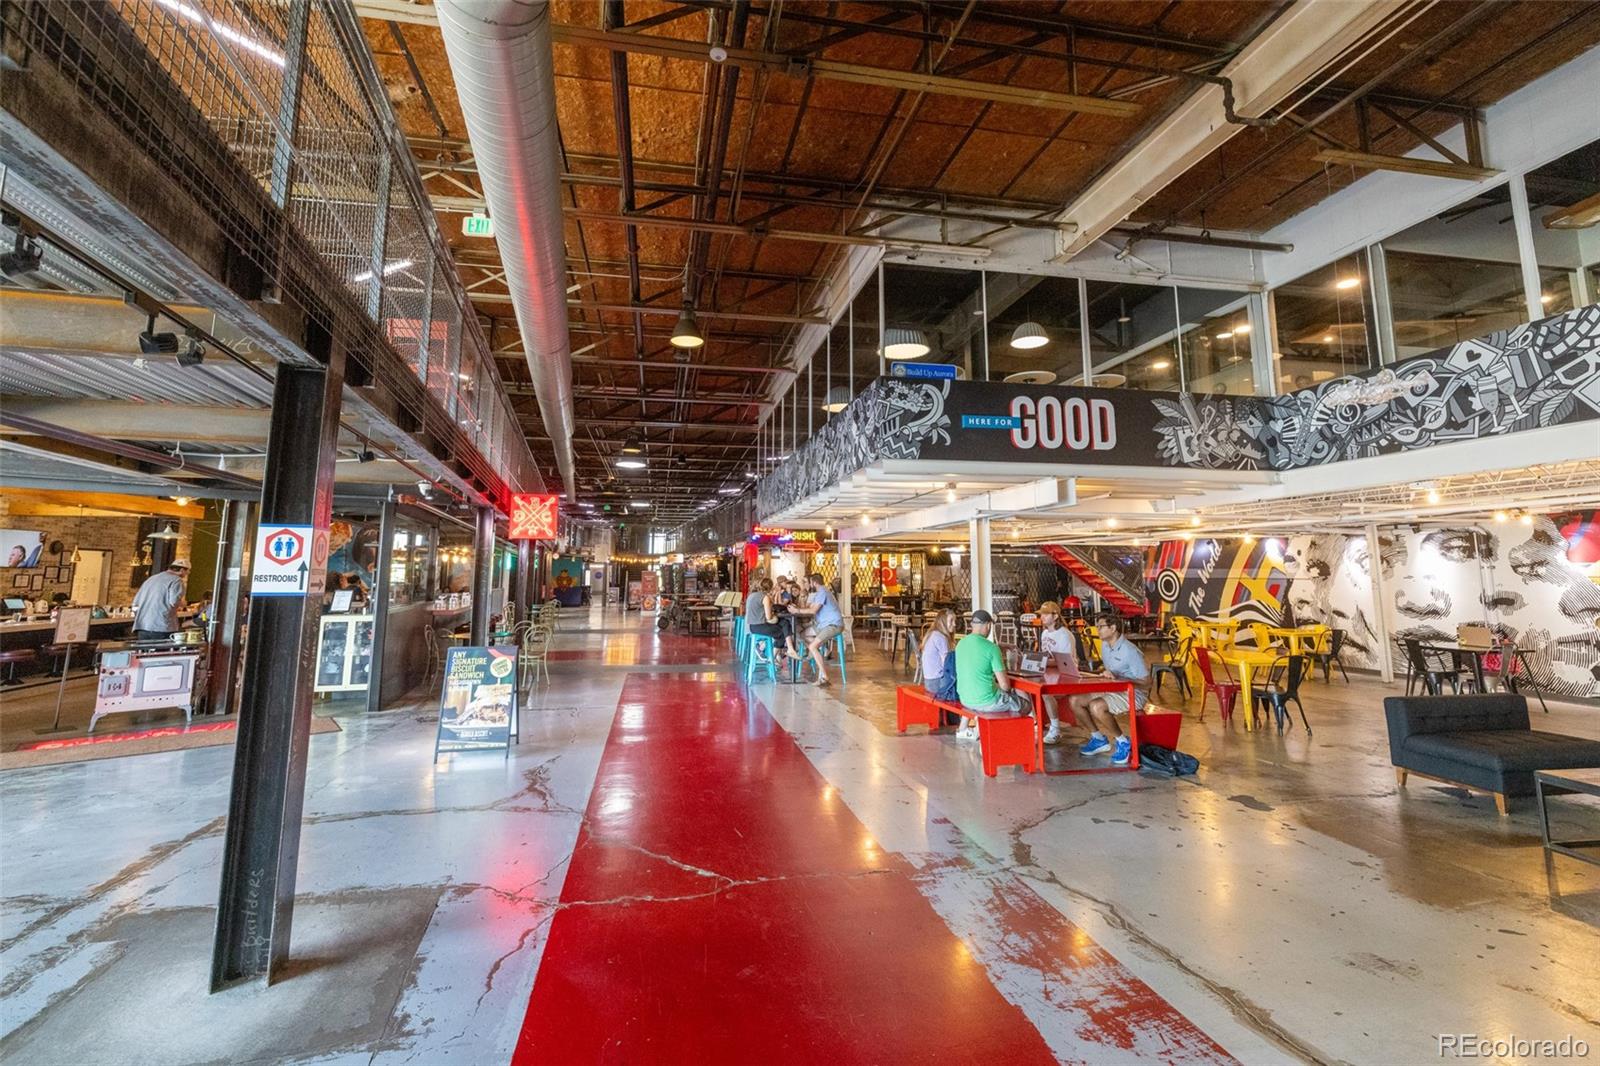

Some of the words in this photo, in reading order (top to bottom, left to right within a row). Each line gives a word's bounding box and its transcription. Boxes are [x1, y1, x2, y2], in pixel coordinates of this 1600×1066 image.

[907, 368, 923, 376] Build
[924, 369, 933, 378] Up
[995, 418, 1012, 426] FOR
[1010, 395, 1117, 450] GOOD
[792, 531, 816, 540] SUSHI
[254, 574, 298, 582] RESTROOMS
[1188, 587, 1206, 616] The
[452, 657, 487, 665] SIGNATURE
[450, 671, 485, 679] SANDWICH
